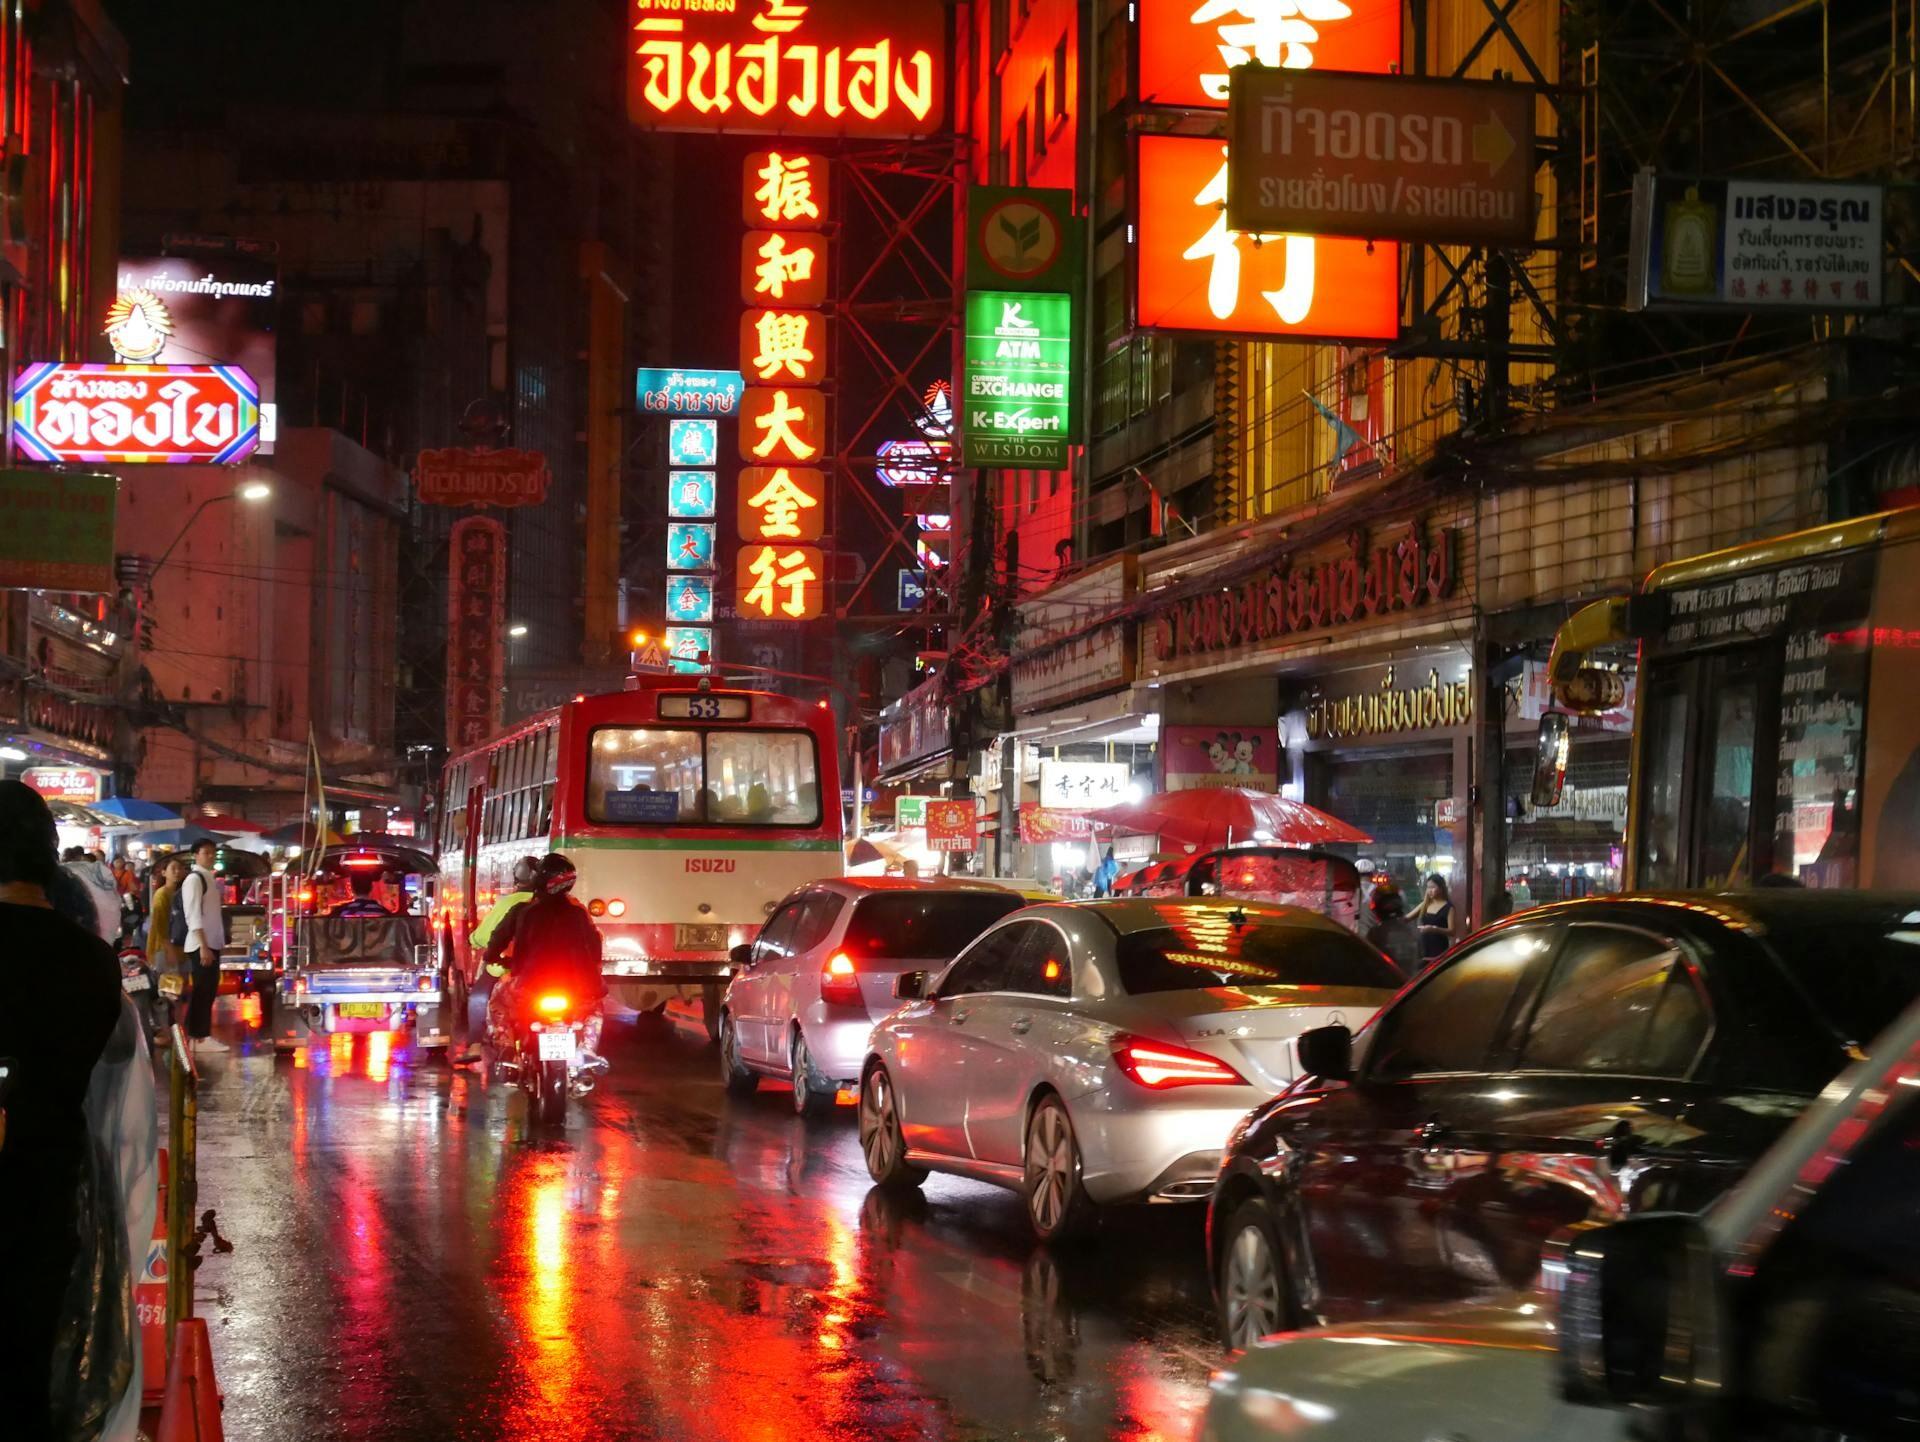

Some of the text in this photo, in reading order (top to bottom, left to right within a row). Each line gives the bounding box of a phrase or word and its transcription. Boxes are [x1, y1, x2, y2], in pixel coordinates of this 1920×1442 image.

[1260, 81, 1464, 165] ที่จอดรถ
[1734, 194, 1870, 231] แสงอรุณ
[1002, 302, 1034, 328] K
[996, 341, 1041, 358] ATM
[50, 373, 148, 400] ห้างทอง
[743, 152, 820, 618] 振和興大金行
[971, 375, 1009, 383] CURRENCY
[971, 382, 1064, 399] EXCHANGE
[37, 380, 235, 448] ทองใบ
[972, 407, 1061, 433] K-Expert
[974, 443, 1059, 457] WISDOM
[1008, 436, 1025, 444] THE
[688, 698, 720, 720] 53
[685, 858, 736, 873] ISUZU
